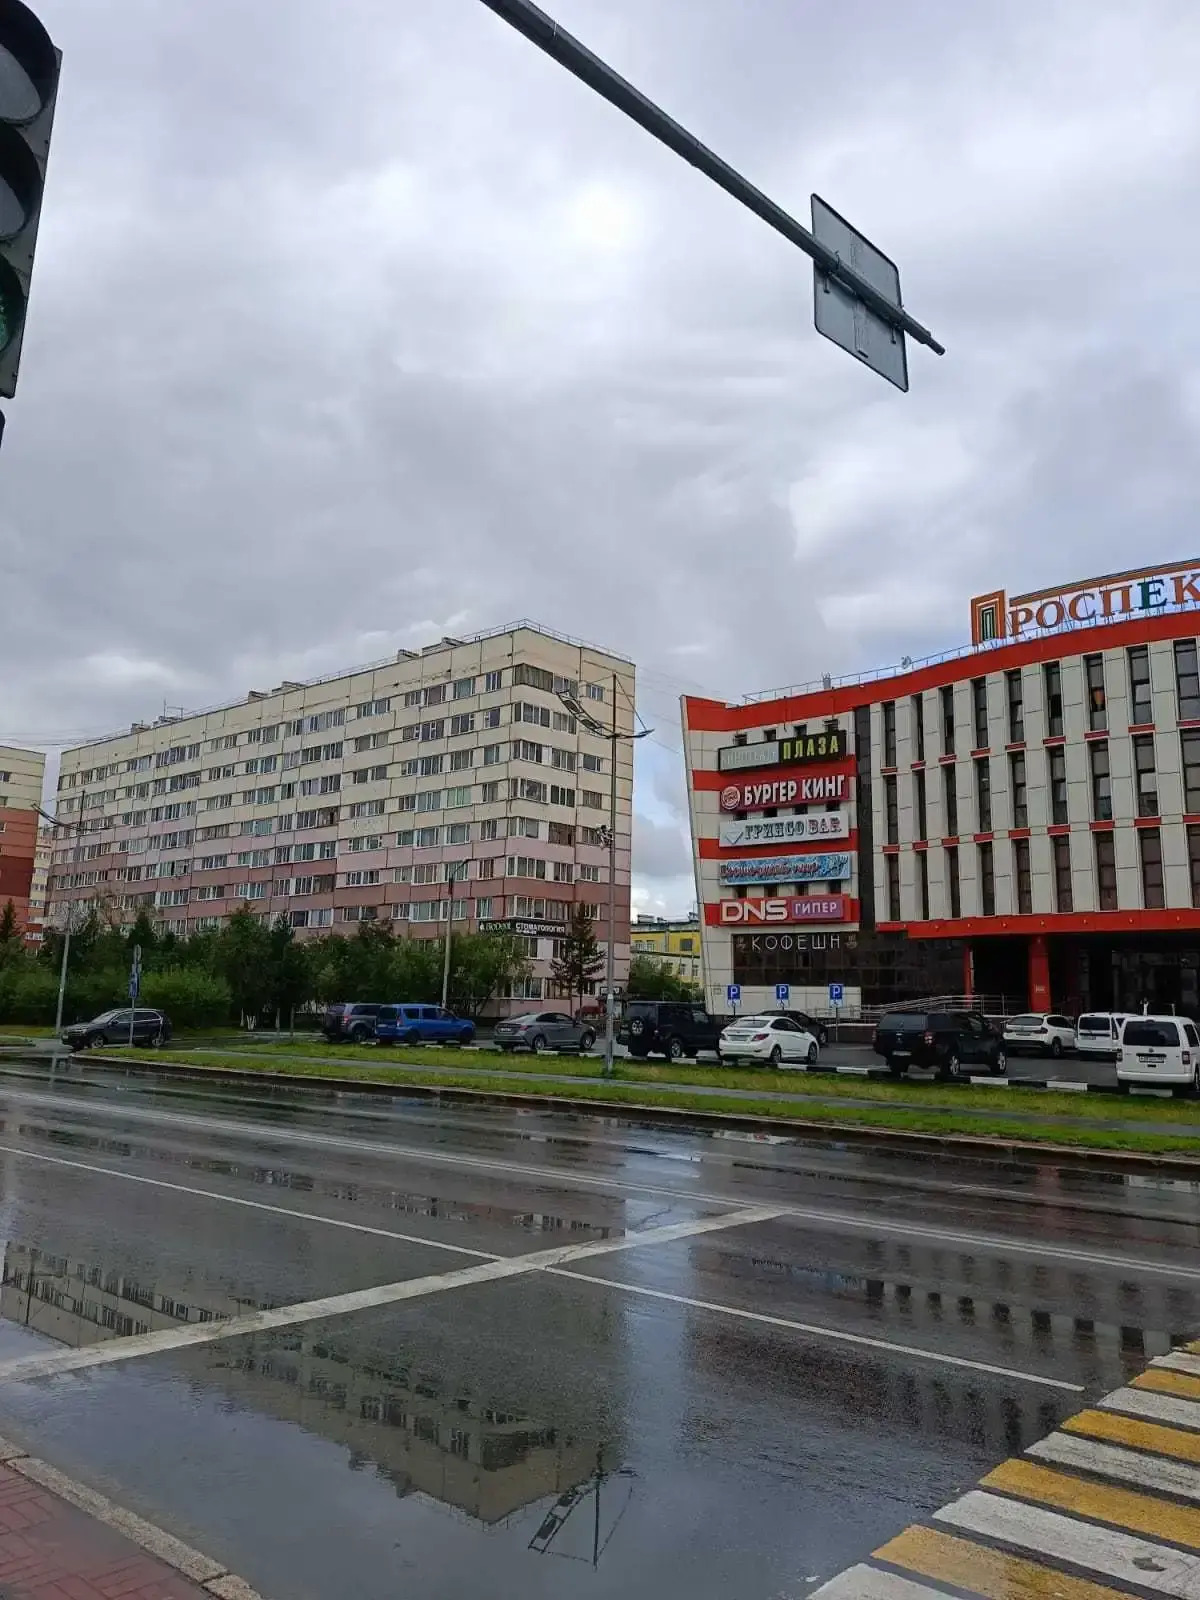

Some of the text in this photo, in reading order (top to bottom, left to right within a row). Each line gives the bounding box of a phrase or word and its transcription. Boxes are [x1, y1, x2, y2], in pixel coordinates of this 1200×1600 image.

[783, 735, 840, 760] ПЛАЗА
[744, 780, 797, 806] БУРГЕР
[801, 774, 845, 800] КИНГ
[721, 900, 838, 922] DNS ГИПЕР
